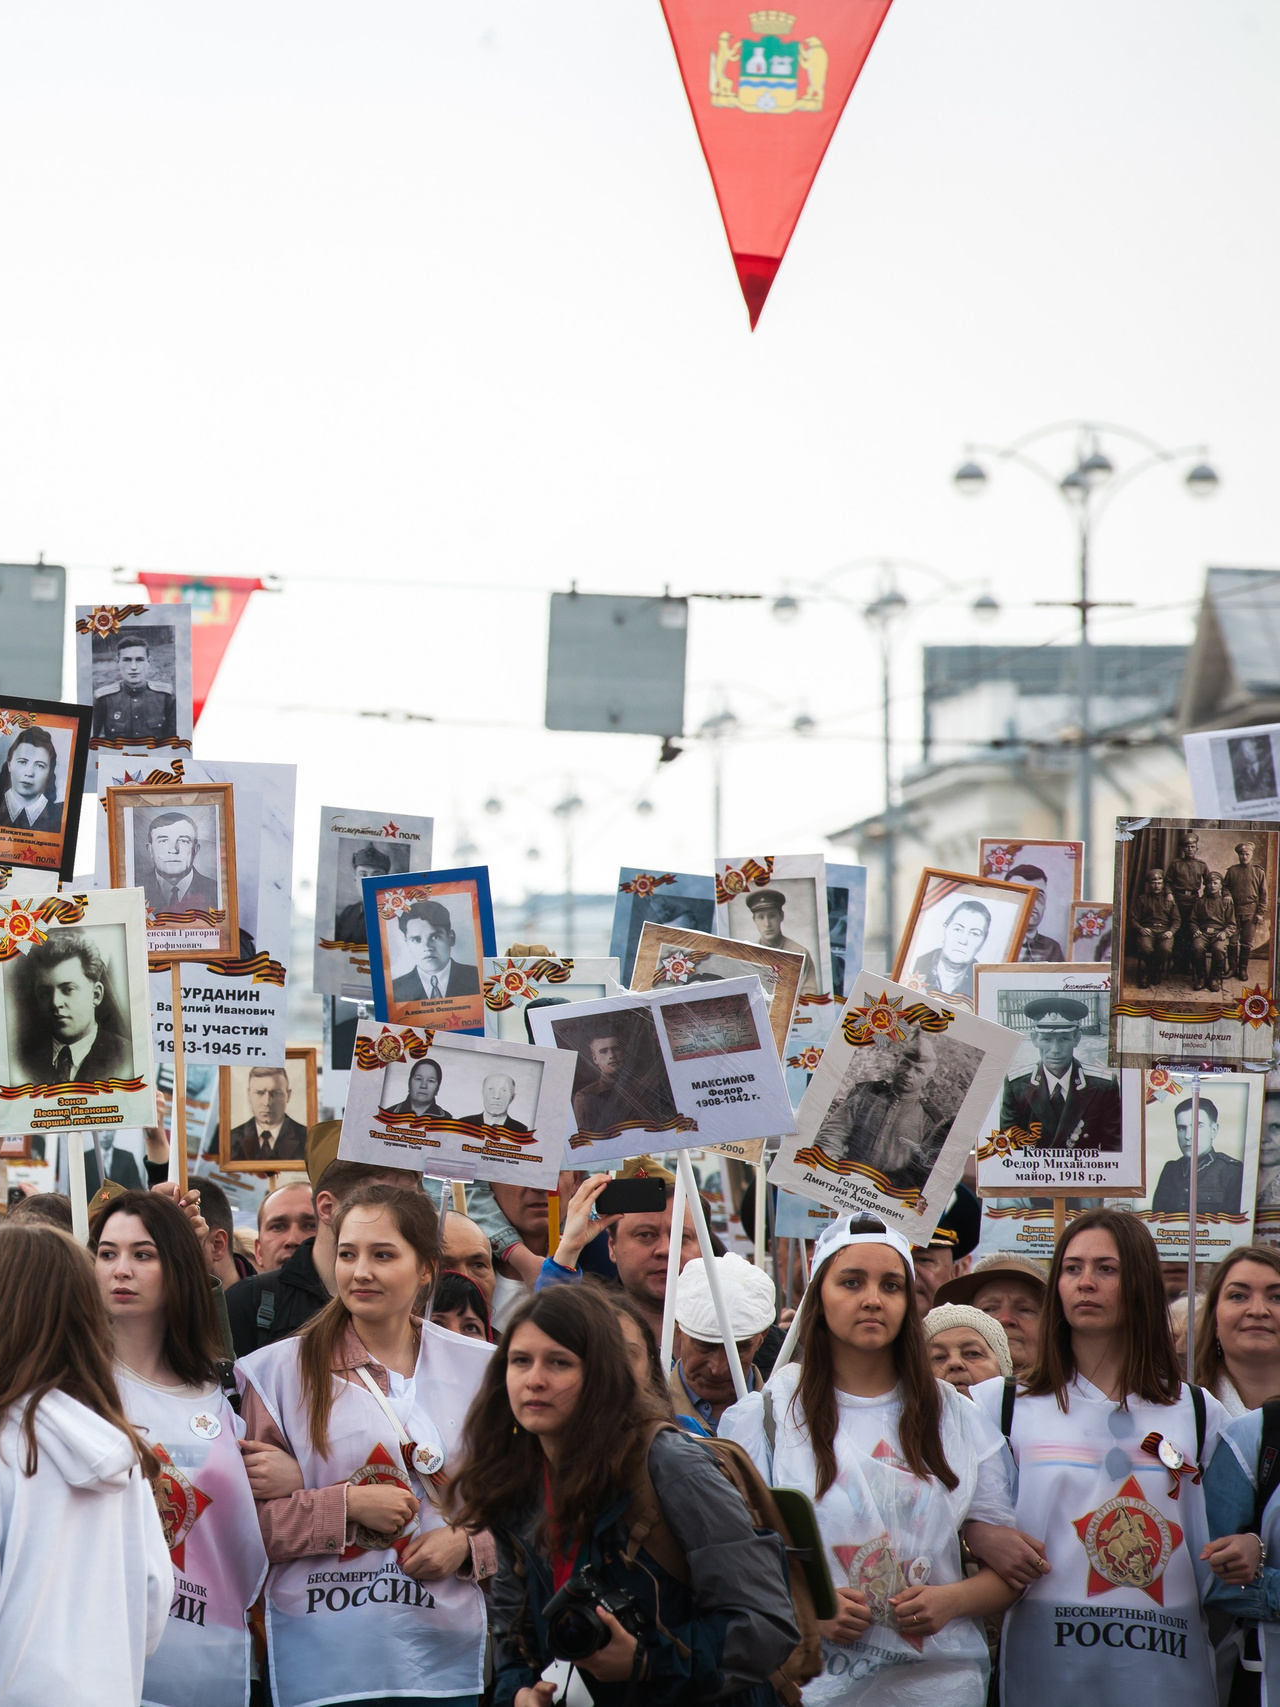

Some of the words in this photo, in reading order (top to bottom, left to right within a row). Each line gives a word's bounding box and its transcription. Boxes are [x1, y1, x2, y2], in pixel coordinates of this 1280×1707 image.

[0, 828, 34, 837] Никитина
[7, 836, 60, 847] Александровна
[147, 929, 177, 937] енский
[179, 929, 220, 939] Григорий
[148, 942, 202, 951] Трофимович
[180, 987, 260, 1002] УРДАНИН
[157, 1002, 211, 1013] Ваилий
[215, 1005, 275, 1016] Иванович
[421, 999, 453, 1007] Никитин
[404, 1007, 435, 1016] Алексей
[436, 1004, 471, 1013] Осипович
[157, 1022, 197, 1033] гоы
[202, 1024, 268, 1036] участия
[1159, 1030, 1203, 1041] Чернышев
[1204, 1032, 1232, 1042] Архип
[247, 1046, 266, 1056] гг.
[691, 1073, 755, 1090] МАКСИМОВ
[708, 1085, 743, 1097] Федор
[58, 1097, 88, 1106] Зонов
[695, 1094, 750, 1108] 1908-1942
[752, 1093, 761, 1101] г.
[34, 1108, 70, 1118] Леонид
[70, 1105, 119, 1116] Иванович
[31, 1117, 72, 1129] старший
[73, 1115, 124, 1126] лейтенант
[385, 1124, 426, 1138] Вьюшкина
[369, 1129, 399, 1142] Татьяна
[400, 1135, 441, 1148] Андреевна
[485, 1140, 522, 1152] Вьюшкин
[720, 1143, 745, 1155] 2000
[1023, 1145, 1100, 1159] Кокшаров
[462, 1144, 481, 1153] Иван
[482, 1147, 543, 1163] Константинович
[1002, 1159, 1040, 1170] Федор
[1044, 1159, 1119, 1169] Михайлович
[1015, 1171, 1056, 1183] майор,
[1060, 1171, 1085, 1181] 1918
[1088, 1174, 1106, 1184] г.р.
[838, 1176, 878, 1200] Голубев
[803, 1172, 848, 1197] Дмитрий
[849, 1191, 905, 1220] Андреевич
[833, 1195, 866, 1212] Сержа
[1023, 1225, 1054, 1234] Крживи
[1157, 1228, 1209, 1237] Крживикий
[1016, 1233, 1037, 1242] Вера
[1173, 1238, 1231, 1246] Альонсович
[179, 1579, 207, 1598] ПОЛК
[1055, 1606, 1157, 1623] БЕССМЕРТНЫЙ
[1158, 1614, 1188, 1630] ПОЛК
[1054, 1621, 1188, 1659] РОССИИ
